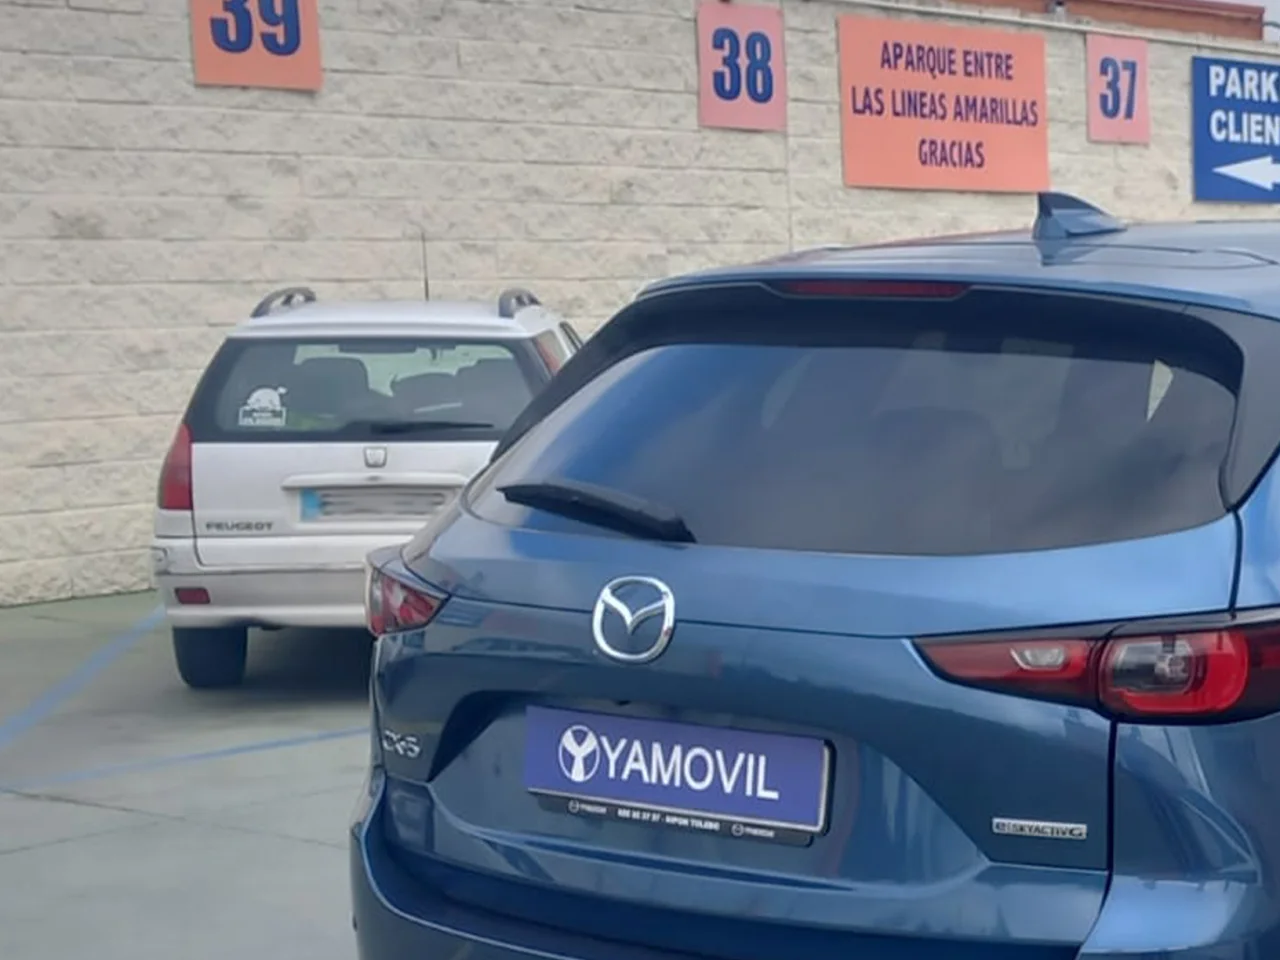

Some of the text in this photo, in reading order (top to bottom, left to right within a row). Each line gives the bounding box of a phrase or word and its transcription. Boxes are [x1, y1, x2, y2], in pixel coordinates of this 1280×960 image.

[209, 0, 302, 57] 39
[711, 27, 775, 104] 38
[880, 41, 1014, 81] APARQUE ENTRE
[1099, 57, 1138, 121] 37
[851, 86, 1039, 128] LAS LINEAS AMARILLAS
[918, 138, 986, 169] GRACIAS
[600, 735, 780, 801] YAMOVIL
